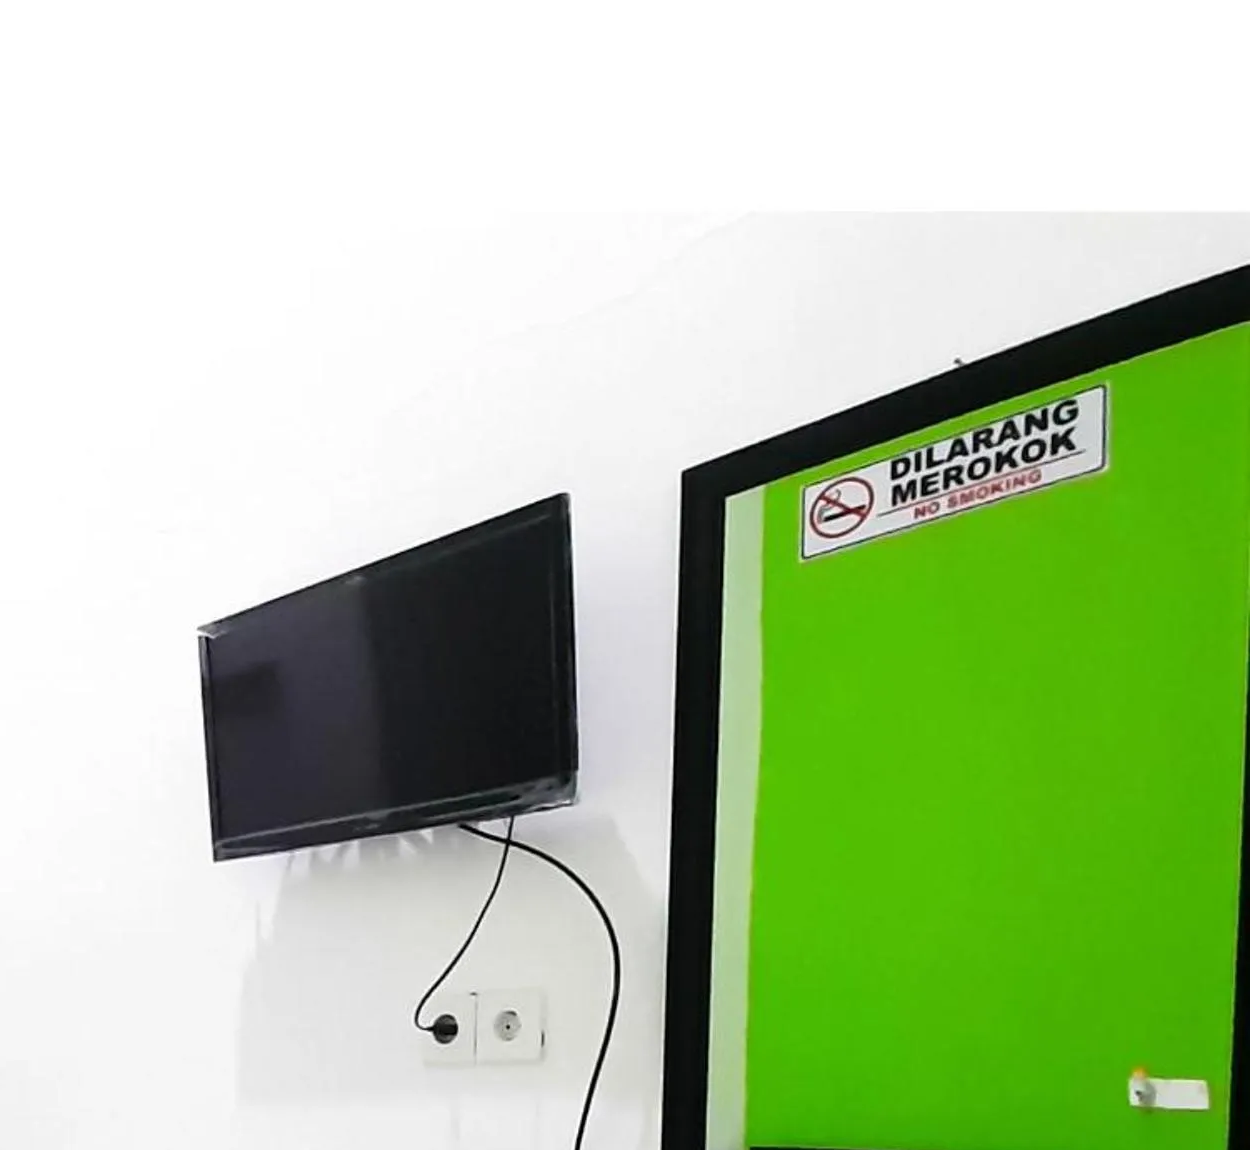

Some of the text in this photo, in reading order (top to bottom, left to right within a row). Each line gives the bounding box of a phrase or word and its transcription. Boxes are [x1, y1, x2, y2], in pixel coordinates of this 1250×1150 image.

[890, 399, 1080, 481] DILARANG
[890, 427, 1077, 507] MEROKOK
[913, 469, 1042, 520] NO SMOKING
